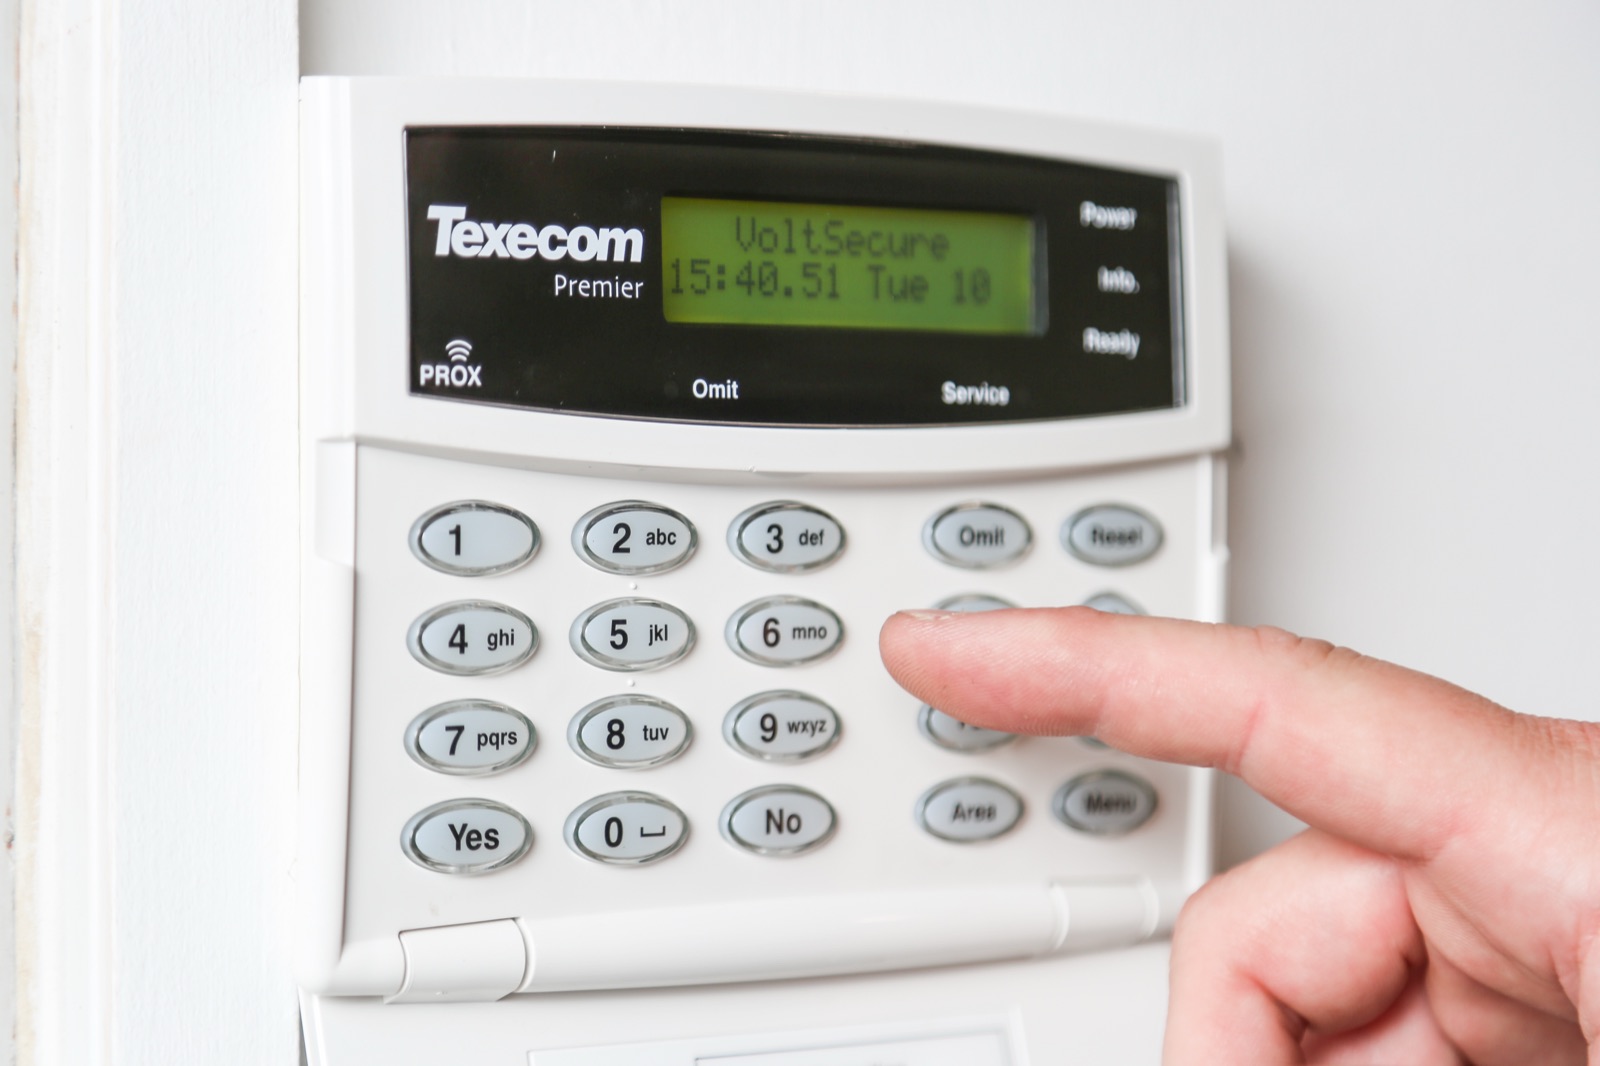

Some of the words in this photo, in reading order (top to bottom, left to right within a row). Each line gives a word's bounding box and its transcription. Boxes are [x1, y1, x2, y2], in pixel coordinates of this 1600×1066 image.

[1079, 200, 1138, 230] Power
[426, 204, 644, 263] Texecom
[735, 215, 949, 260] VoltSecure
[554, 273, 644, 299] Premier
[669, 258, 840, 300] 15:40.51
[868, 265, 929, 303] Tue
[953, 268, 992, 305] 10
[1082, 327, 1140, 360] Ready
[419, 364, 482, 388] PROX
[692, 378, 739, 400] Omit
[941, 380, 1010, 406] Service
[448, 524, 462, 556] 1
[612, 522, 631, 554] 2
[645, 529, 677, 547] abc
[766, 523, 784, 554] 3
[798, 529, 825, 547] def
[959, 525, 1006, 548] Omit
[448, 623, 469, 655] 4
[487, 628, 515, 652] ghi
[609, 618, 629, 650] 5
[648, 624, 669, 646] jkl
[762, 617, 781, 648] 6
[791, 624, 828, 641] mno
[445, 724, 466, 757] 7
[476, 728, 519, 752] pqrs
[606, 718, 626, 750] 8
[642, 724, 670, 742] tuv
[759, 713, 778, 743] 9
[787, 717, 828, 736] wxyz
[765, 808, 803, 836] No
[951, 801, 997, 823] Area
[448, 822, 501, 852] Yes
[604, 816, 624, 848] 0
